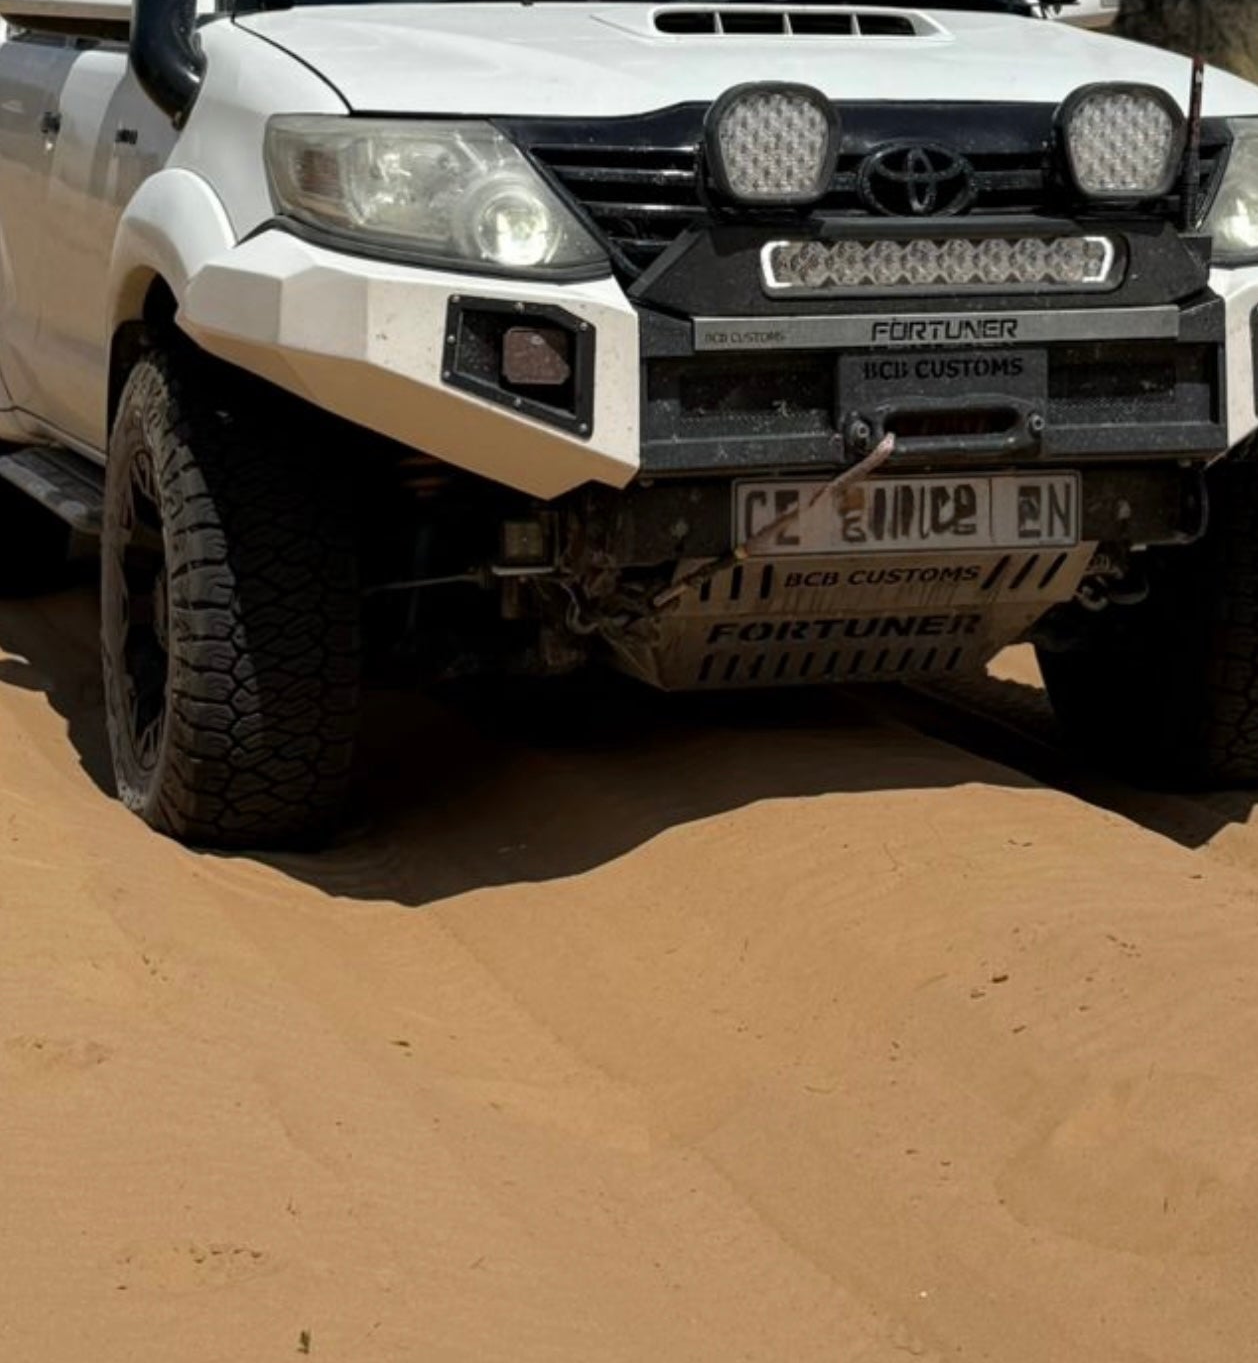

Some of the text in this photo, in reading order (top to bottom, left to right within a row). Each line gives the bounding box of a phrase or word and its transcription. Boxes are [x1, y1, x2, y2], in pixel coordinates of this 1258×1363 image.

[704, 331, 786, 344] BCB CUSTOMS
[870, 318, 1019, 341] FORTUNER
[863, 357, 1024, 381] BCB CUSTOMS
[784, 566, 982, 588] BCB CUSTOMS
[706, 613, 983, 645] FORTUNER
